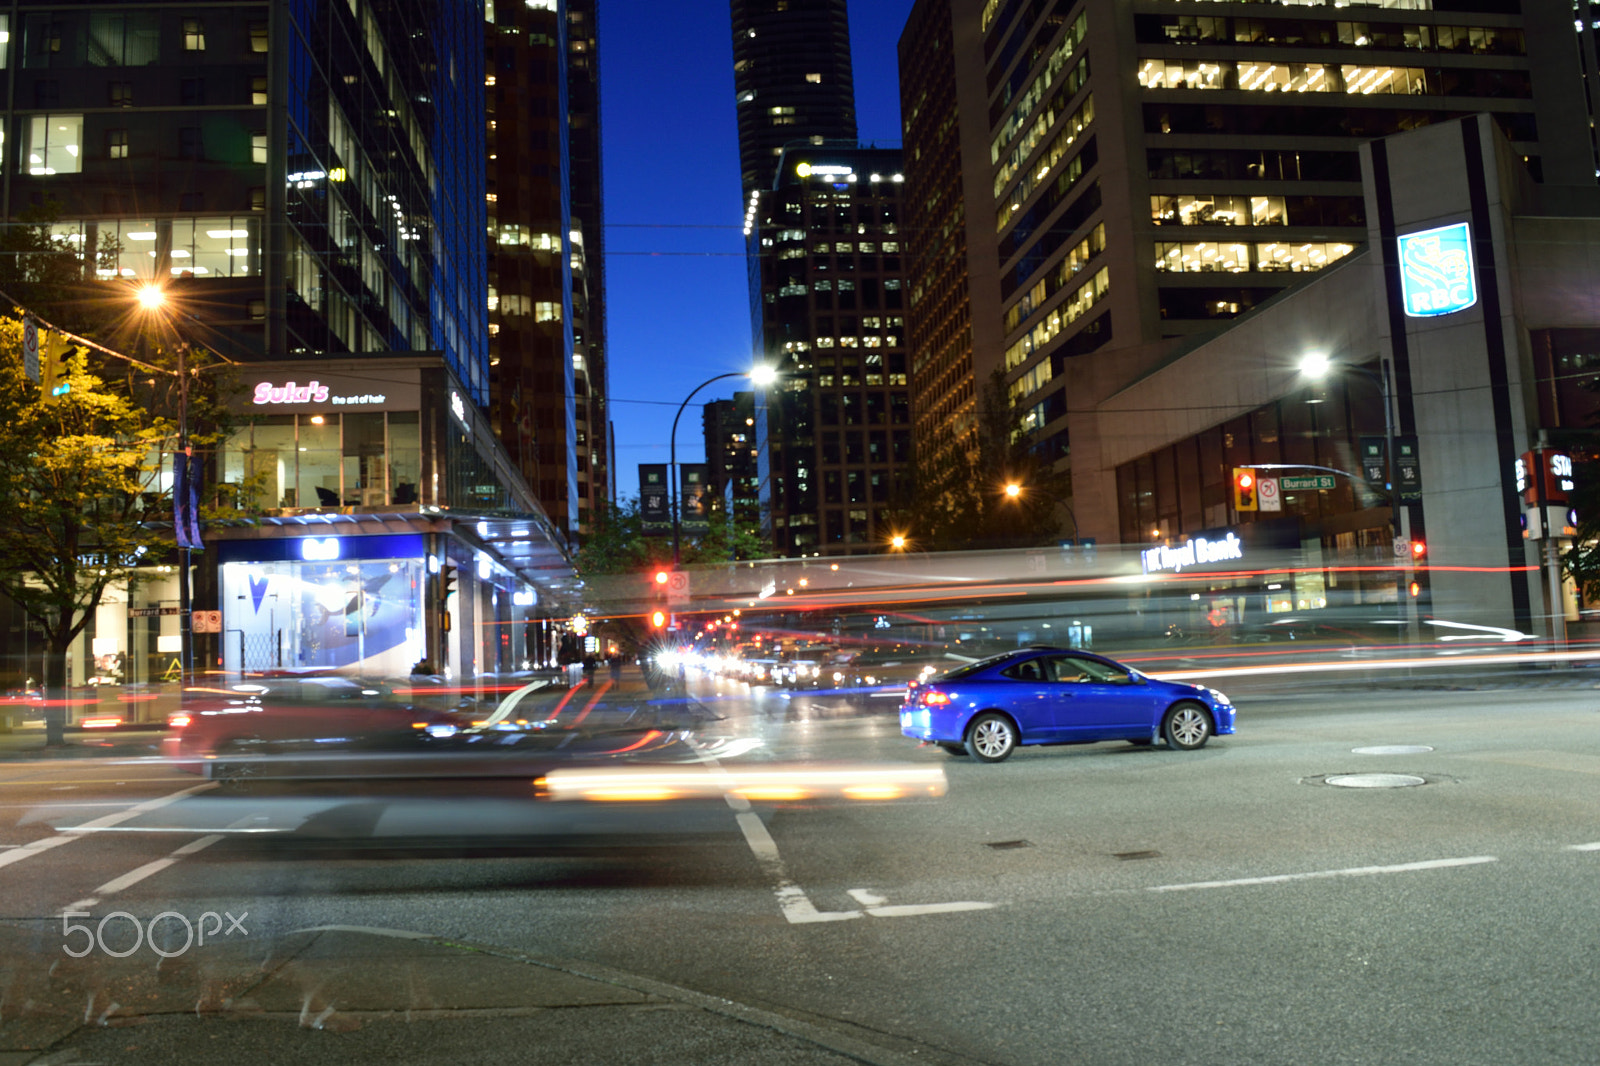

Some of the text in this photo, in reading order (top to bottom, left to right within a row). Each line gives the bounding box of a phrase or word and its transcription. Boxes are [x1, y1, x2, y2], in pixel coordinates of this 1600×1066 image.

[1411, 285, 1469, 312] RBC
[253, 381, 329, 404] Suki's
[332, 394, 385, 404] the art of hair
[1284, 477, 1331, 489] Burrard St
[1195, 532, 1242, 564] Bank
[1395, 543, 1407, 553] 99
